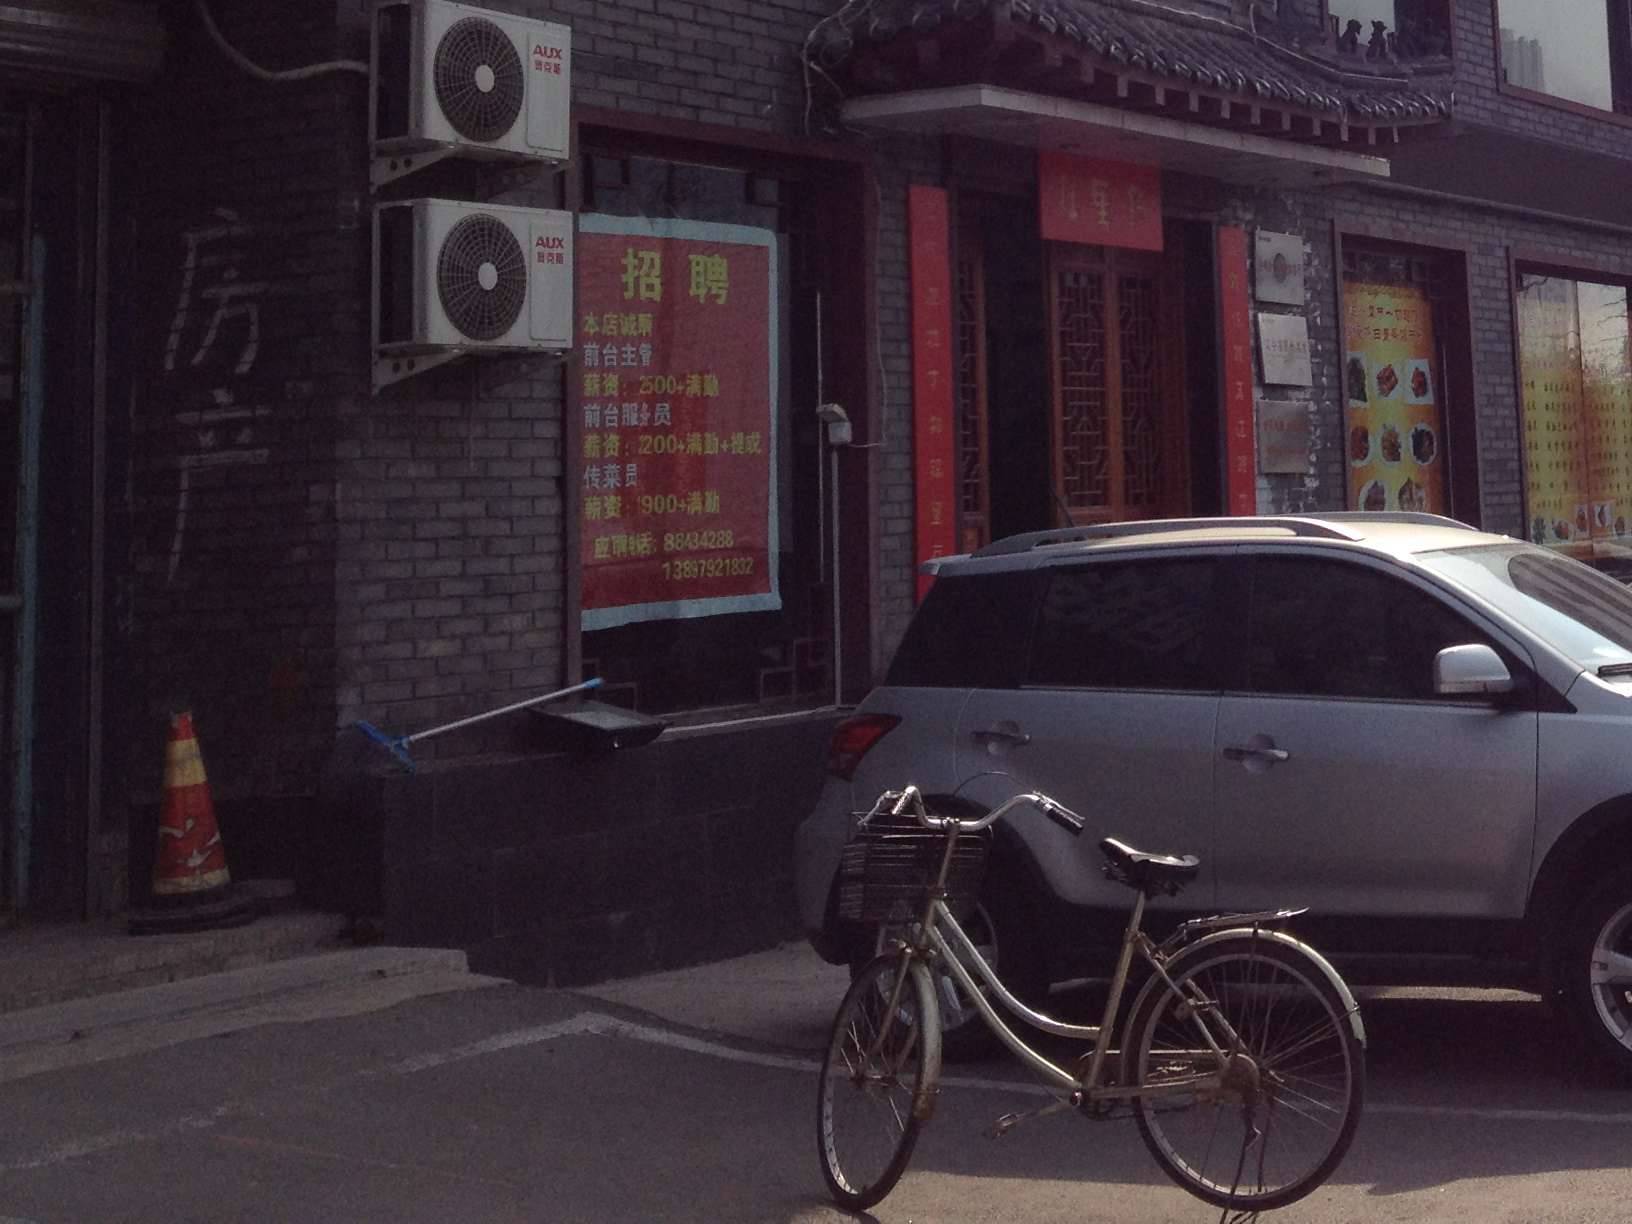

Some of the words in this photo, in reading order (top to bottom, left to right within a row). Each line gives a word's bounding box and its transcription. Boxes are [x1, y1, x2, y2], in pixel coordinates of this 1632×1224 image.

[533, 44, 562, 60] AUX
[536, 236, 564, 249] AUX
[621, 247, 730, 305] 招聘
[583, 342, 652, 367] 前台主管
